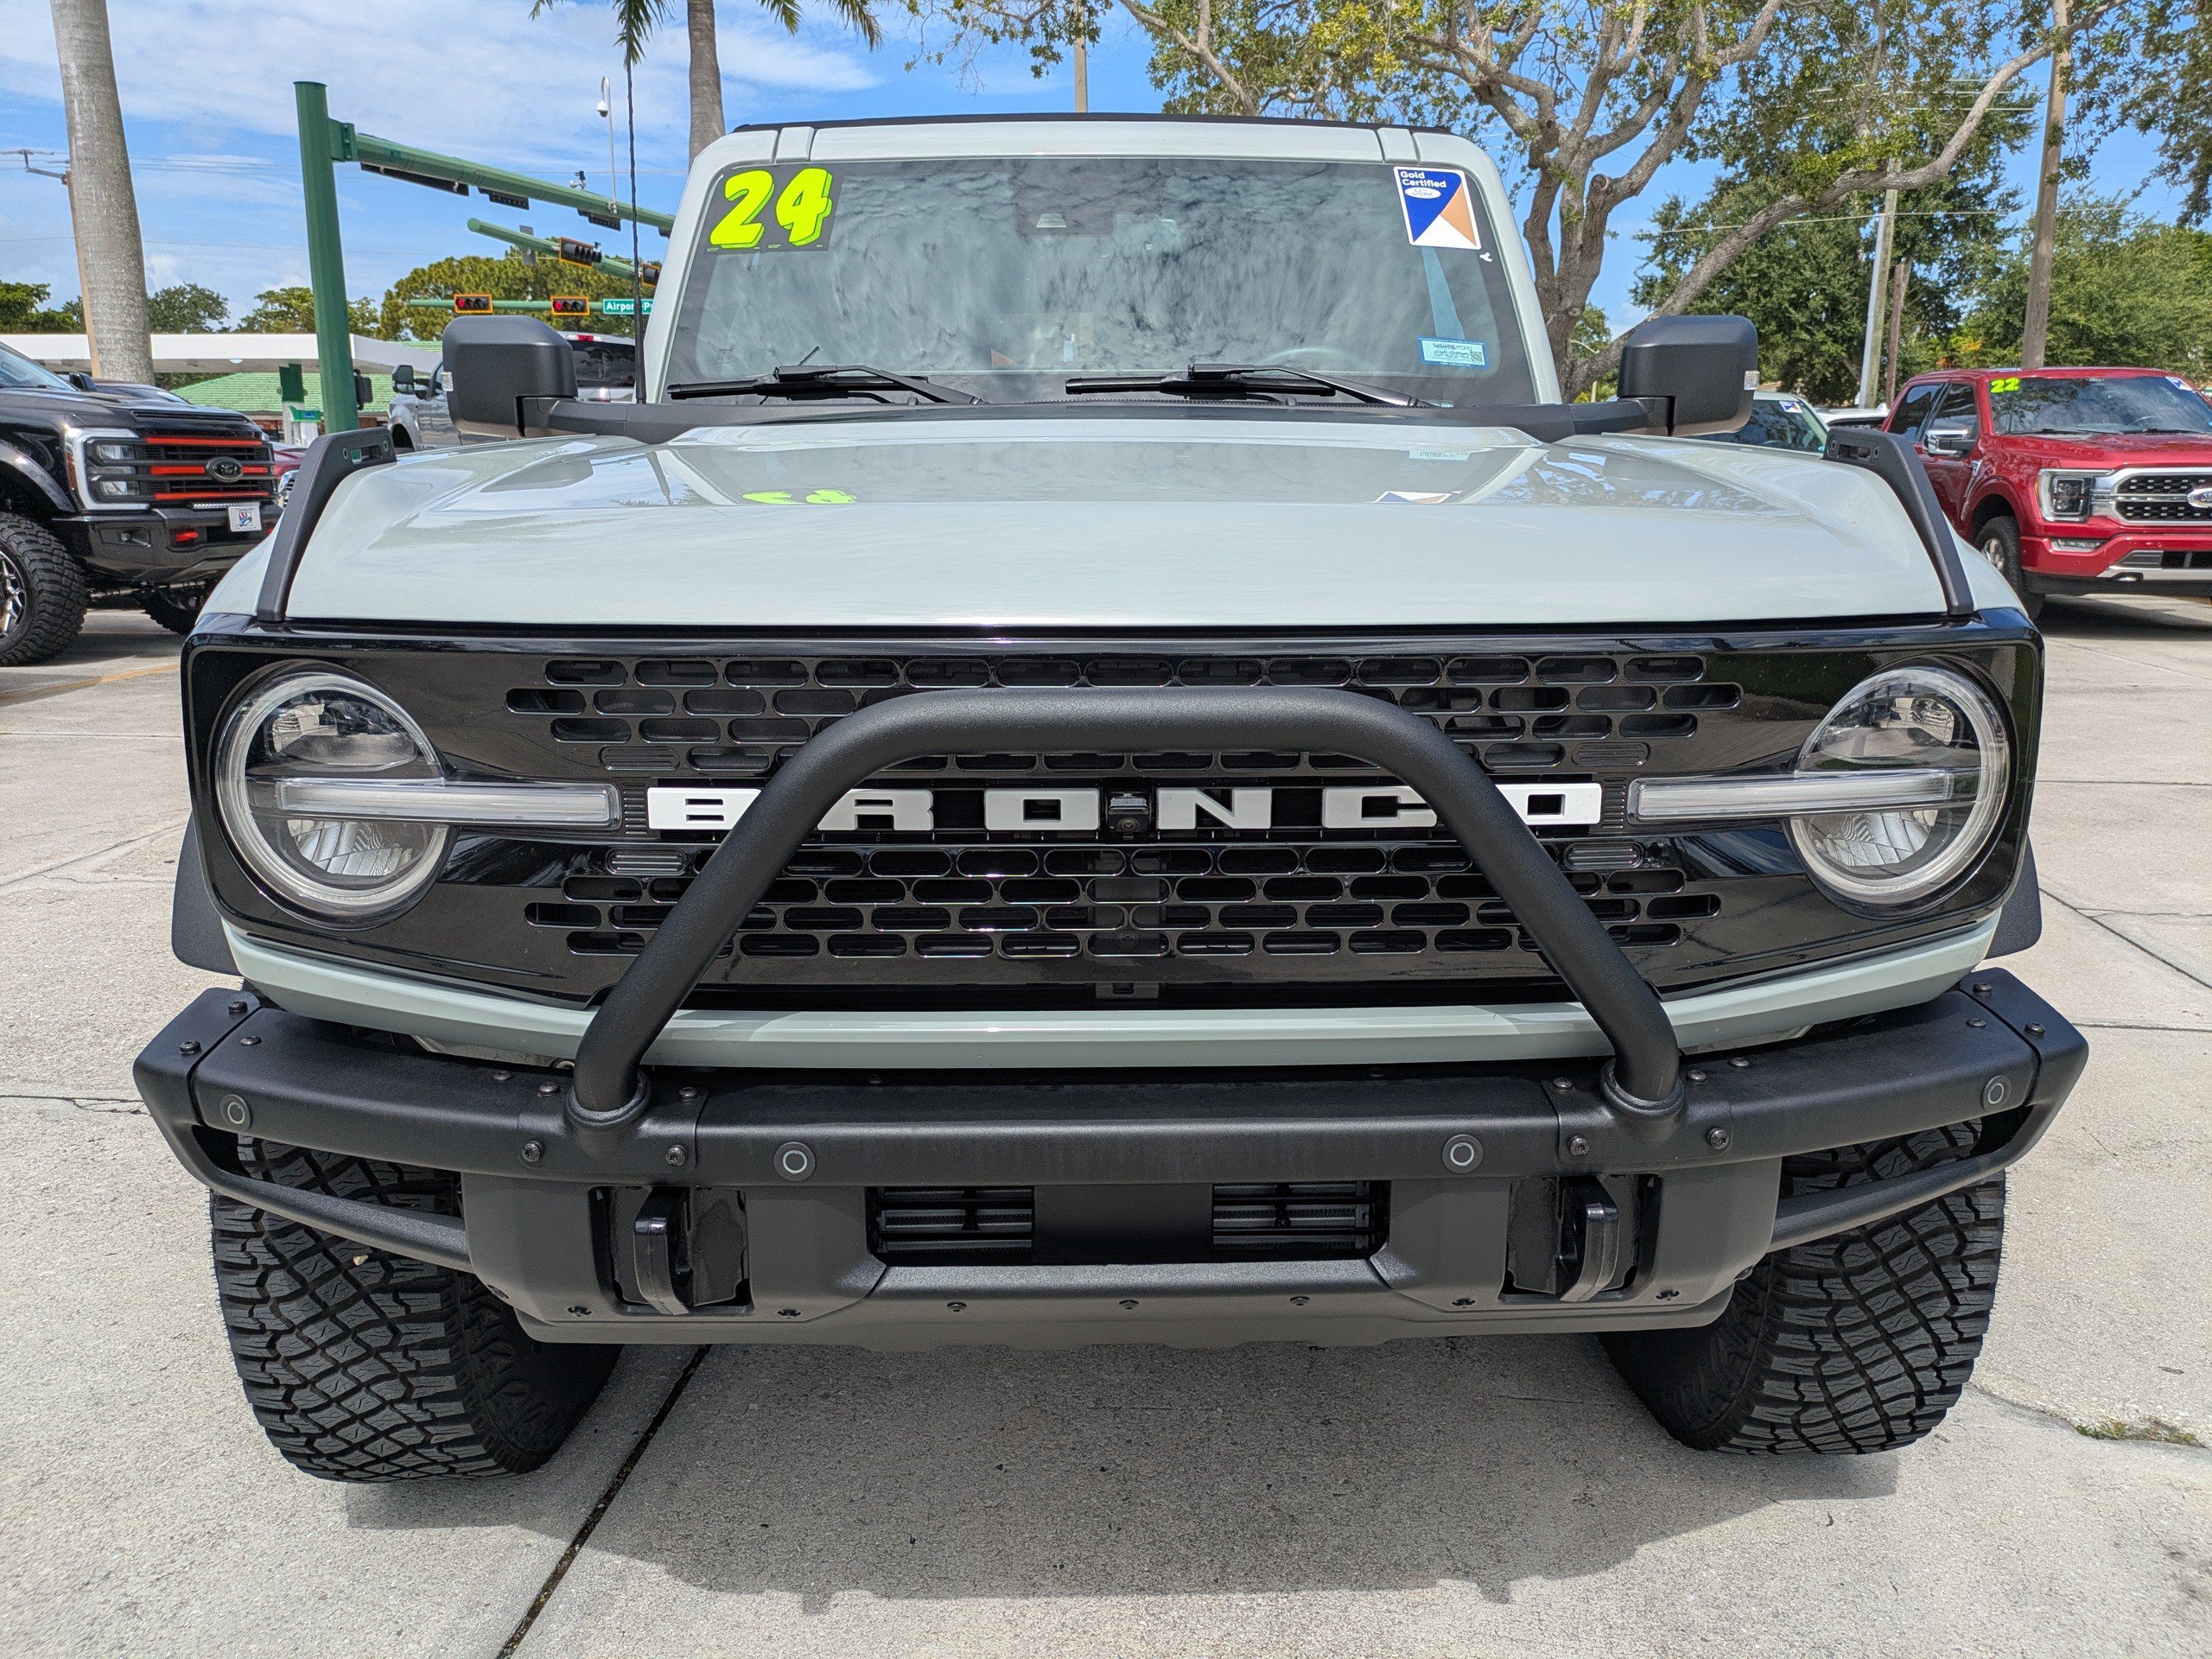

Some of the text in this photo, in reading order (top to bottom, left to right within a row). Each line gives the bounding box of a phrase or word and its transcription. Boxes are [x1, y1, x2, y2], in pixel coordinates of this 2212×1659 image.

[1402, 179, 1446, 188] Certified
[710, 168, 832, 249] 24
[1990, 378, 2019, 393] 22
[647, 782, 1603, 831] BRONCO
